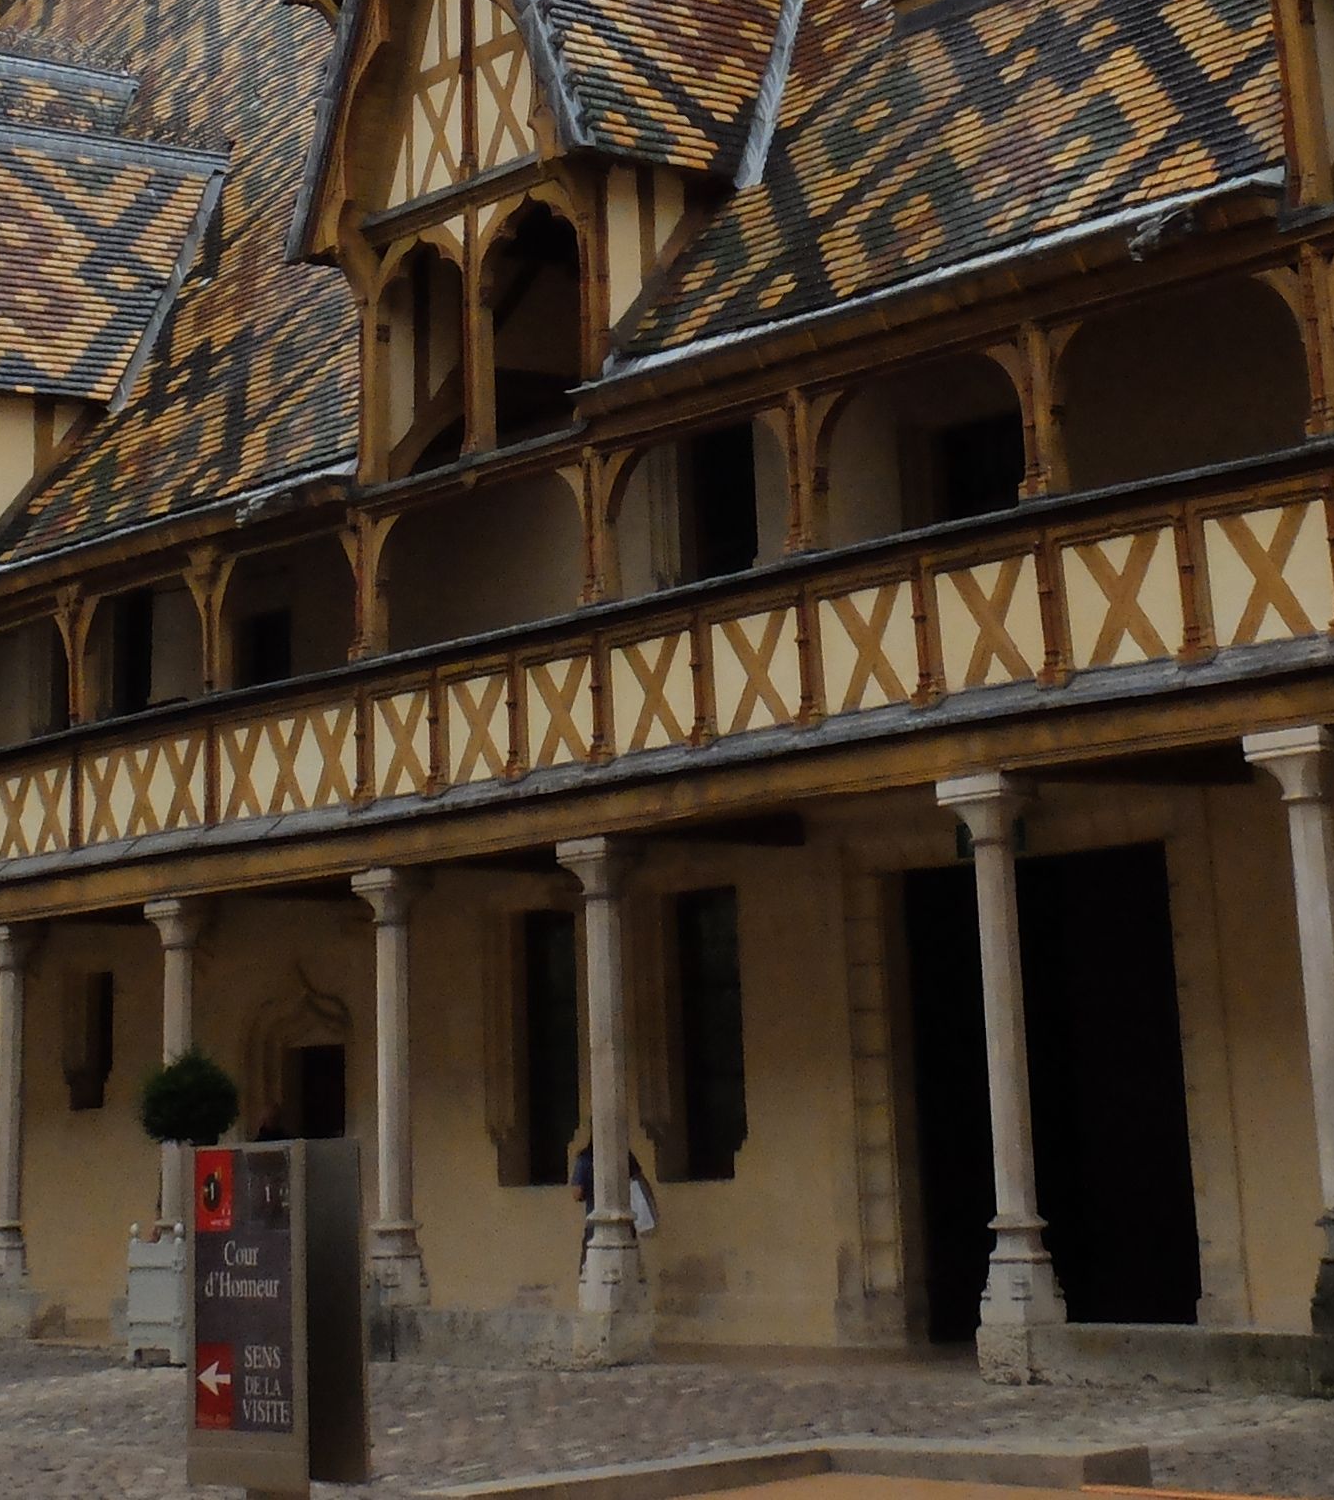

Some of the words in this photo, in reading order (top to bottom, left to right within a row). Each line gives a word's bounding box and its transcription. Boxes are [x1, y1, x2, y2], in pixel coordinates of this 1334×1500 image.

[224, 1240, 260, 1267] Cour
[205, 1271, 280, 1298] d'Honneur
[244, 1345, 282, 1369] SENS
[244, 1375, 262, 1396] DE
[264, 1376, 282, 1397] LA
[242, 1399, 291, 1424] VISITE
